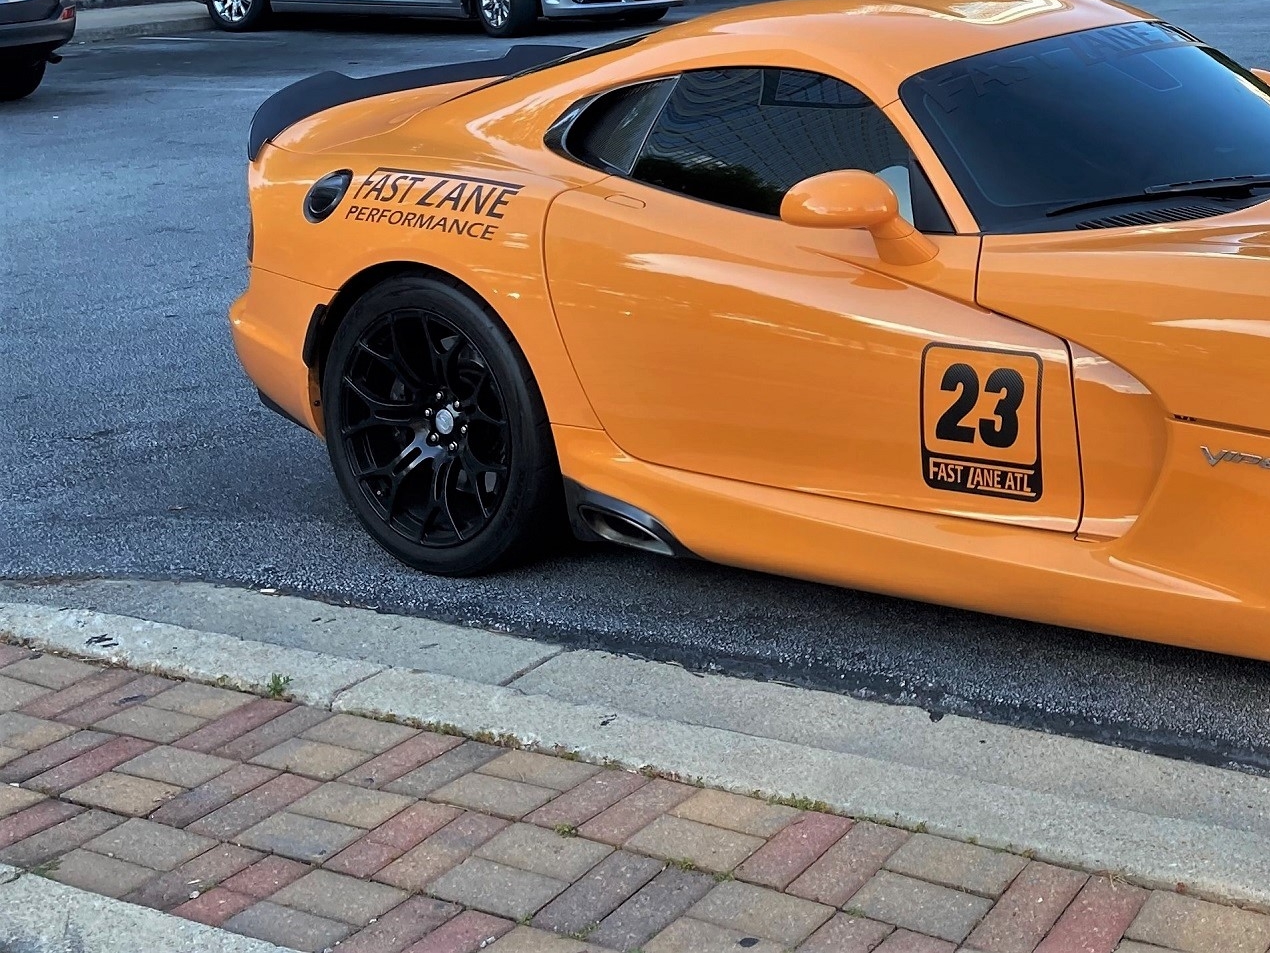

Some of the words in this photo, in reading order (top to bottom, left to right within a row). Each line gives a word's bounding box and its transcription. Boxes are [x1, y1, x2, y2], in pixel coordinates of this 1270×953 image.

[353, 167, 426, 204] FAST
[415, 179, 520, 220] LANE
[344, 205, 500, 242] PERFORMANCE
[935, 362, 1025, 449] 23
[929, 457, 964, 484] FAST
[966, 466, 1003, 489] LANE
[1004, 471, 1033, 493] ATL
